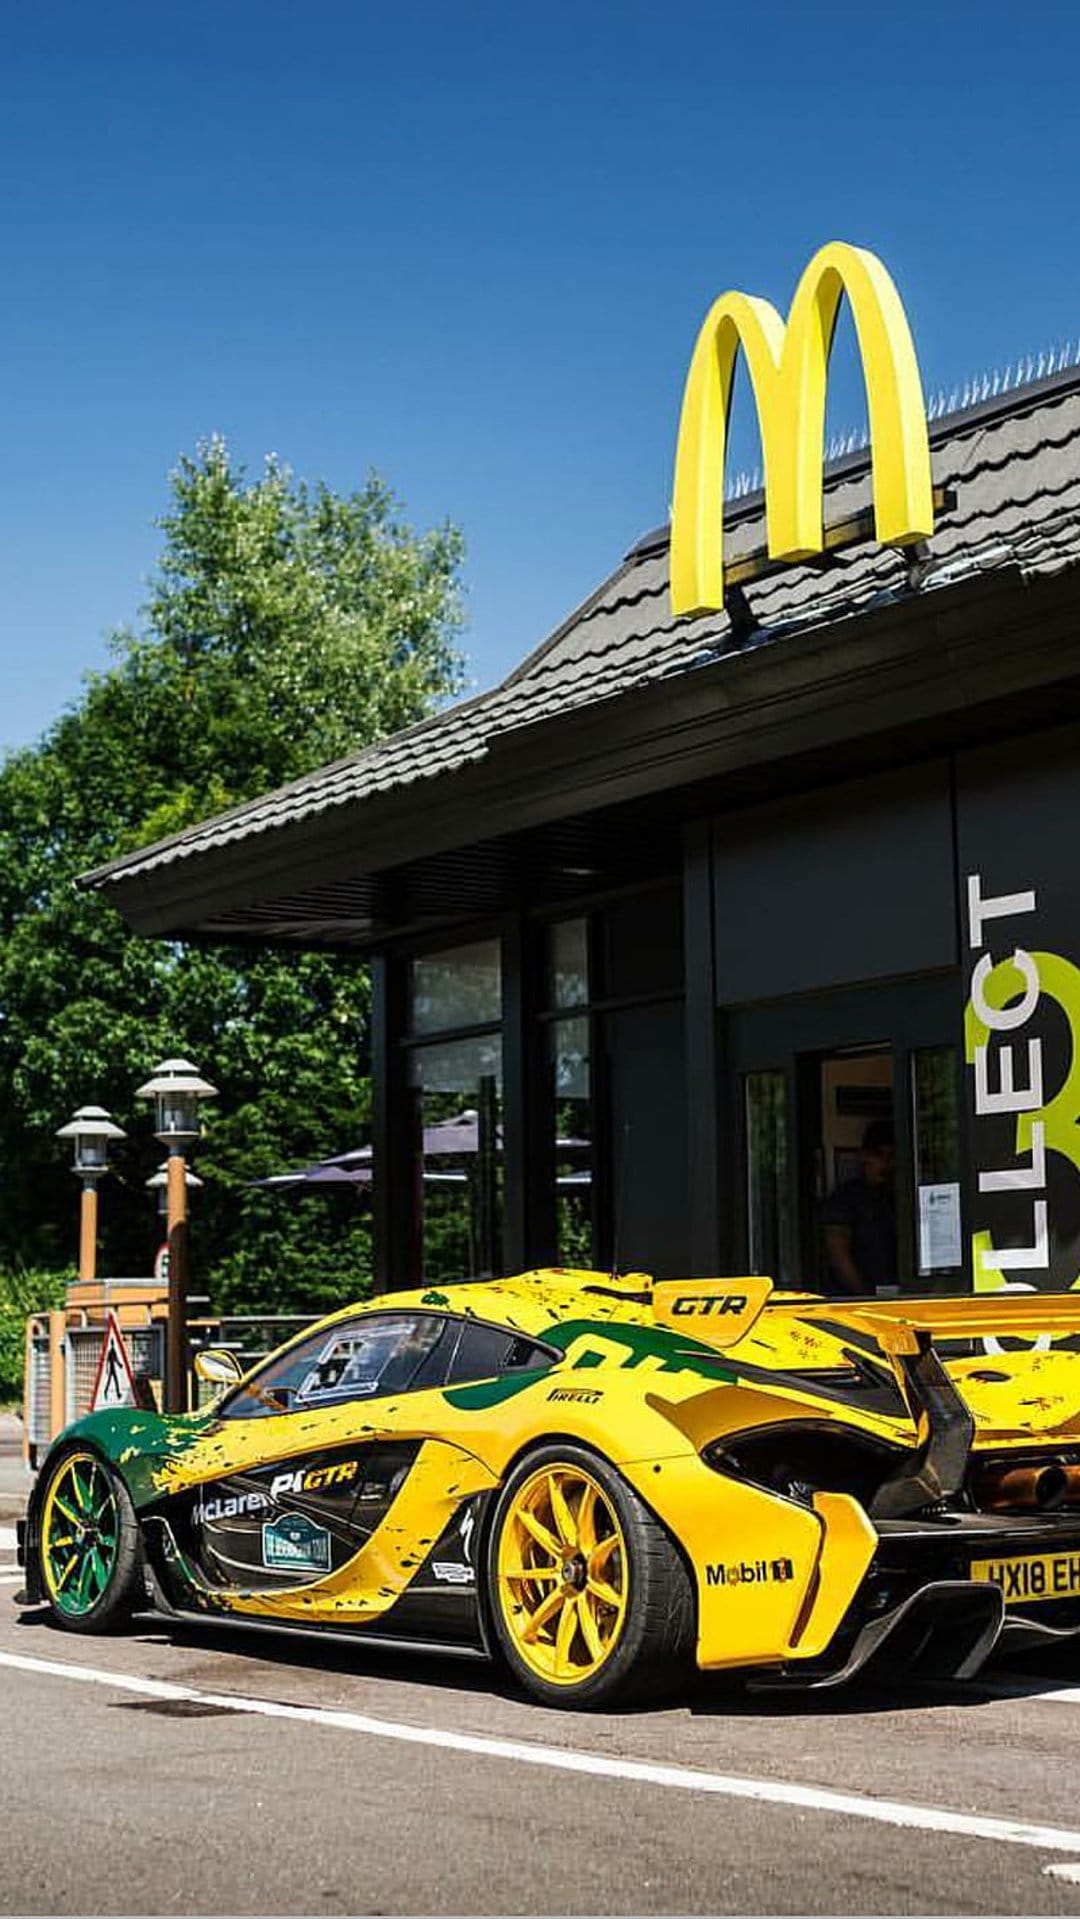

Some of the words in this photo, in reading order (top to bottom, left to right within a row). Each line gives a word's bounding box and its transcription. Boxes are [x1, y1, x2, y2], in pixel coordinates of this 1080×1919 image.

[670, 241, 934, 616] M
[671, 1295, 748, 1316] GTR
[191, 1492, 277, 1526] McLaren
[706, 1560, 767, 1586] Mobil
